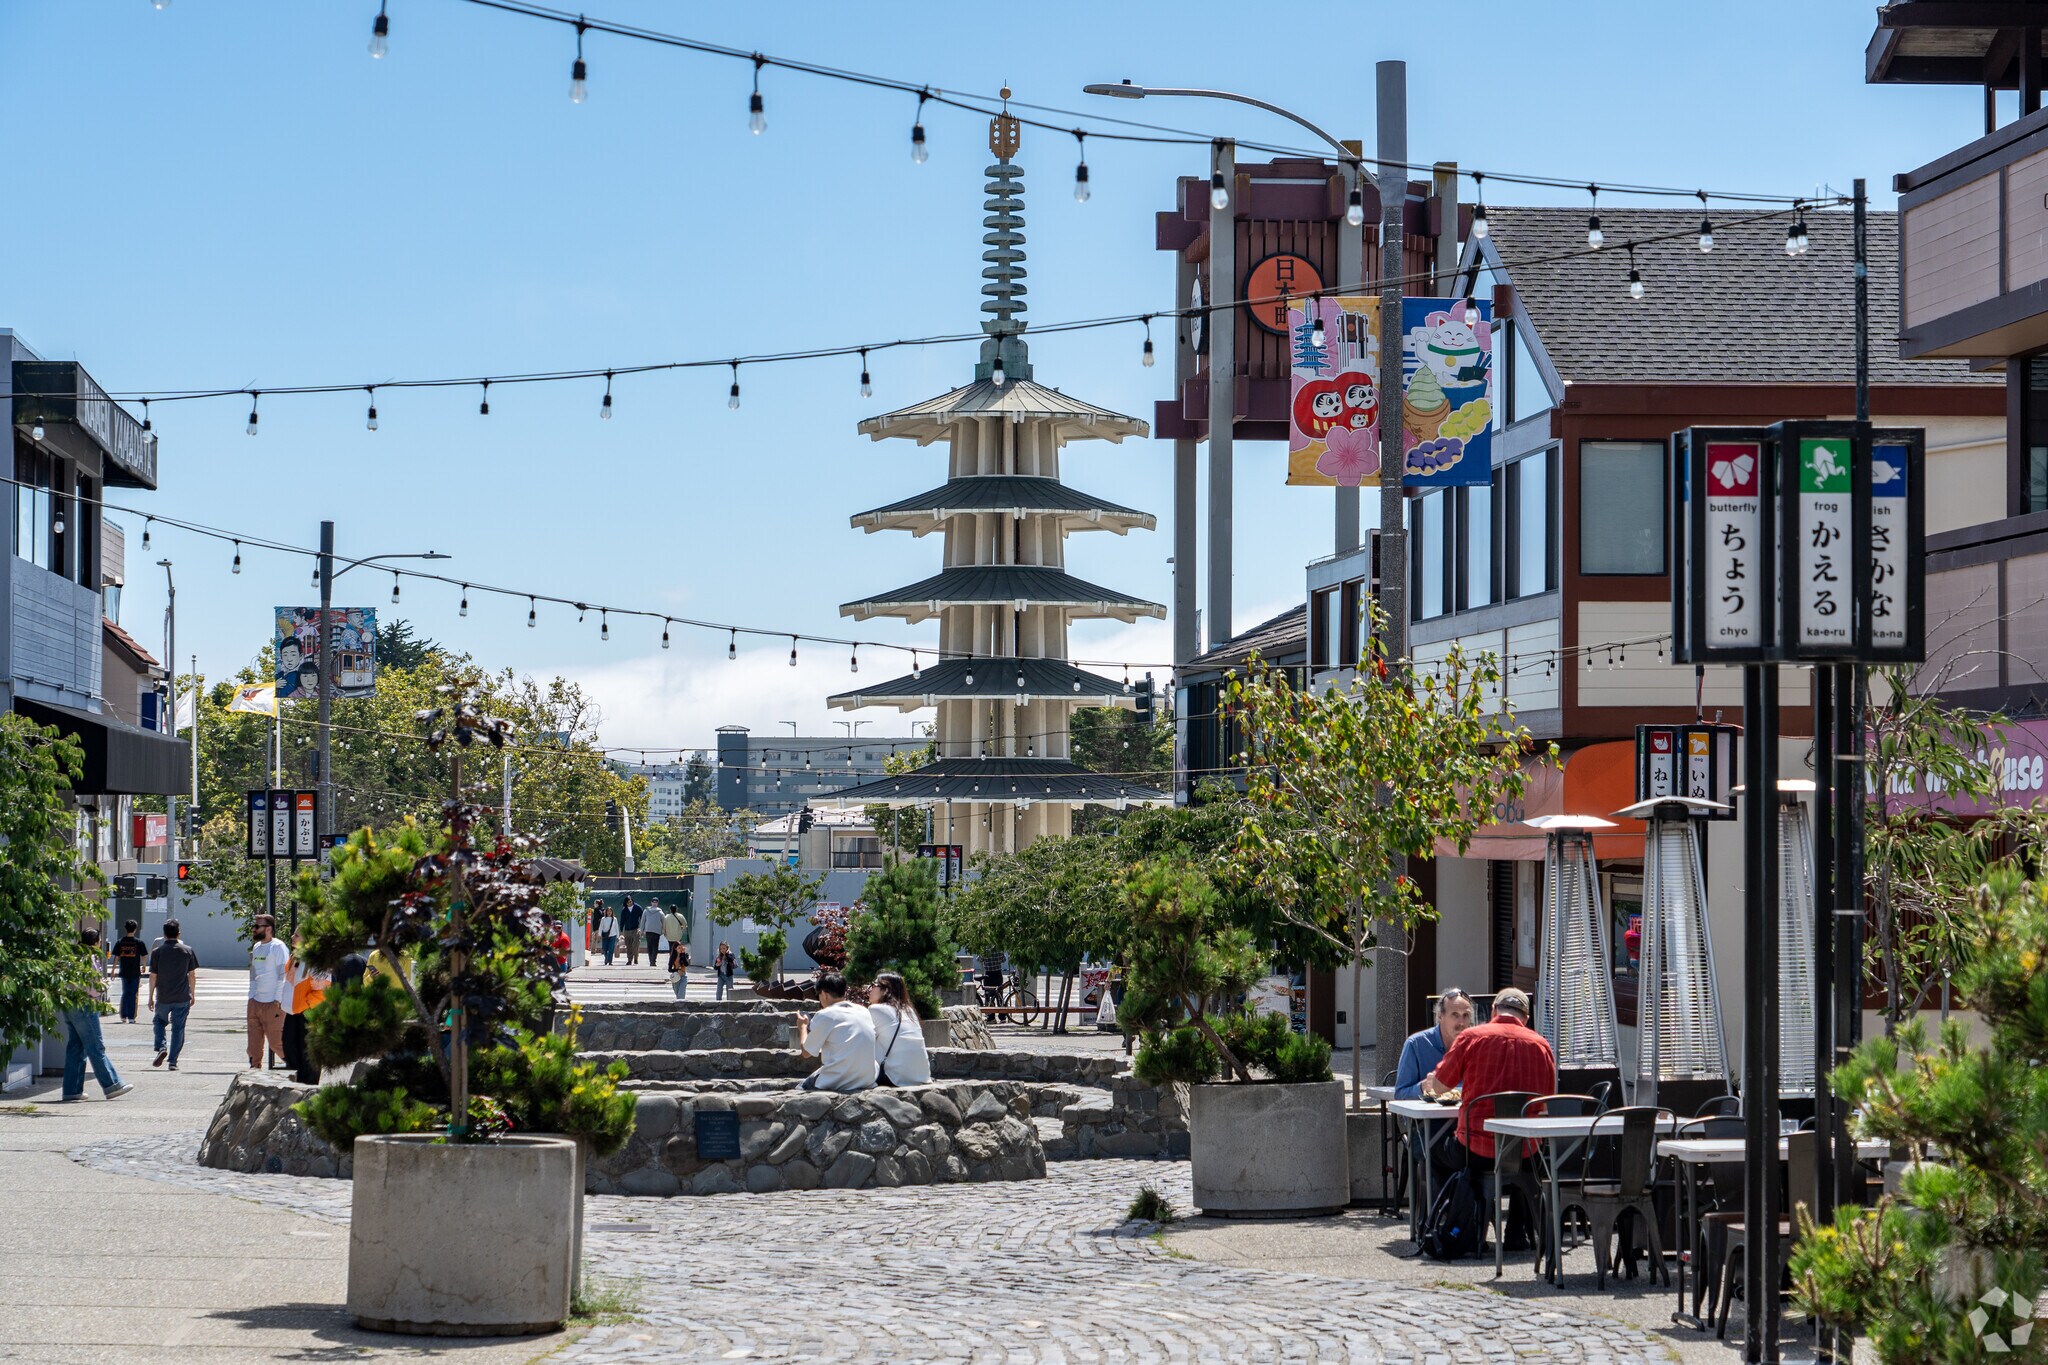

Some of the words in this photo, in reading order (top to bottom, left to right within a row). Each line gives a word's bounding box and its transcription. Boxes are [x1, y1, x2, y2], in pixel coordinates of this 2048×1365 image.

[84, 378, 110, 447] RAMEN
[1709, 502, 1757, 514] butterfly
[1814, 502, 1838, 513] frog
[1873, 506, 1891, 515] ish
[1721, 523, 1746, 615] ちょう
[1811, 520, 1840, 616] かえる
[1871, 525, 1895, 617] さかな
[1720, 626, 1748, 637] chyo
[1654, 767, 1668, 797] ねこ
[1691, 769, 1706, 798] いぬ
[300, 818, 310, 846] かぶと
